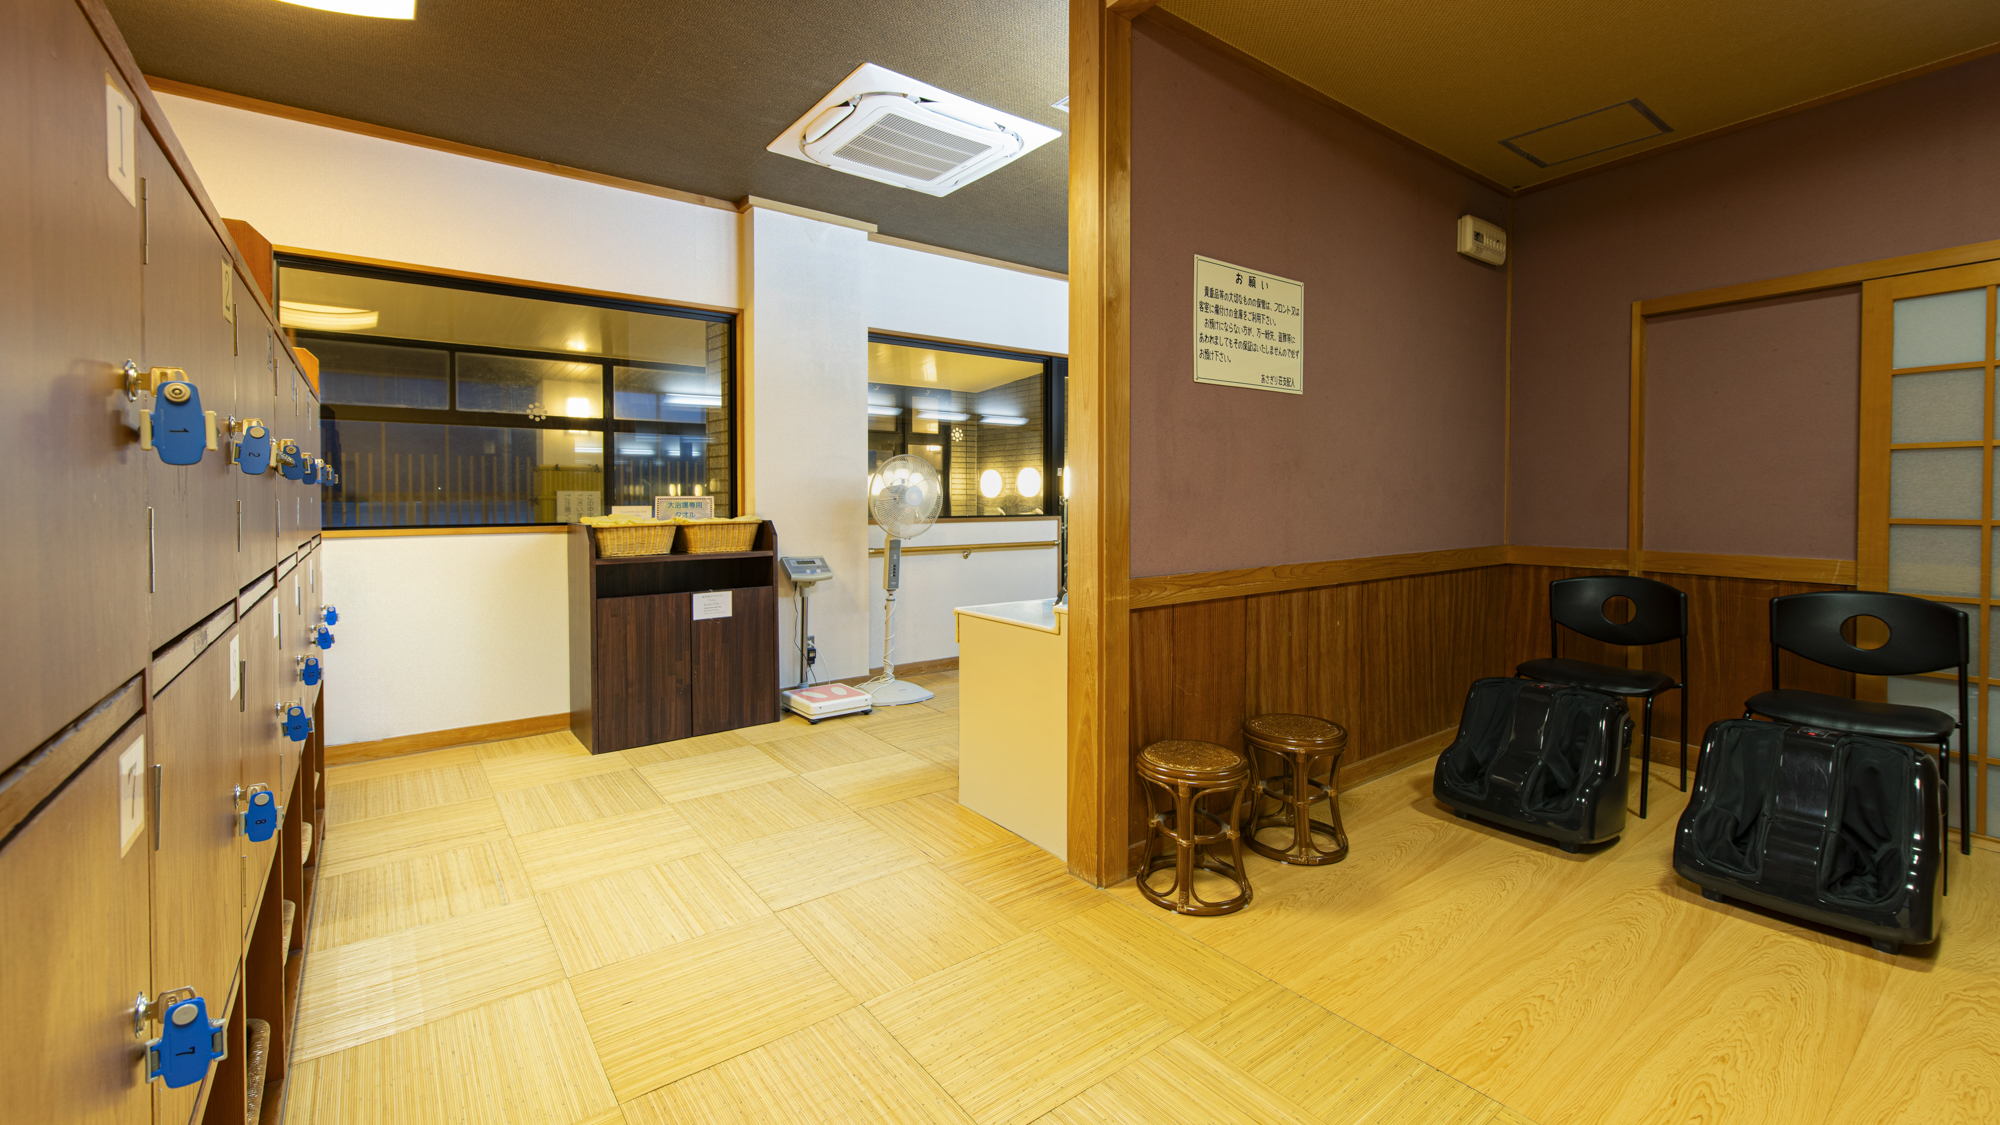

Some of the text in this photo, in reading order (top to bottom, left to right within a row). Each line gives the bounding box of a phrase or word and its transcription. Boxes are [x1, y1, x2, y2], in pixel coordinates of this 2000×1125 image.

[117, 104, 127, 179] 1
[224, 270, 231, 312] 2
[1235, 272, 1269, 290] お願い
[667, 501, 703, 509] 大浴場専用
[127, 761, 138, 820] 7
